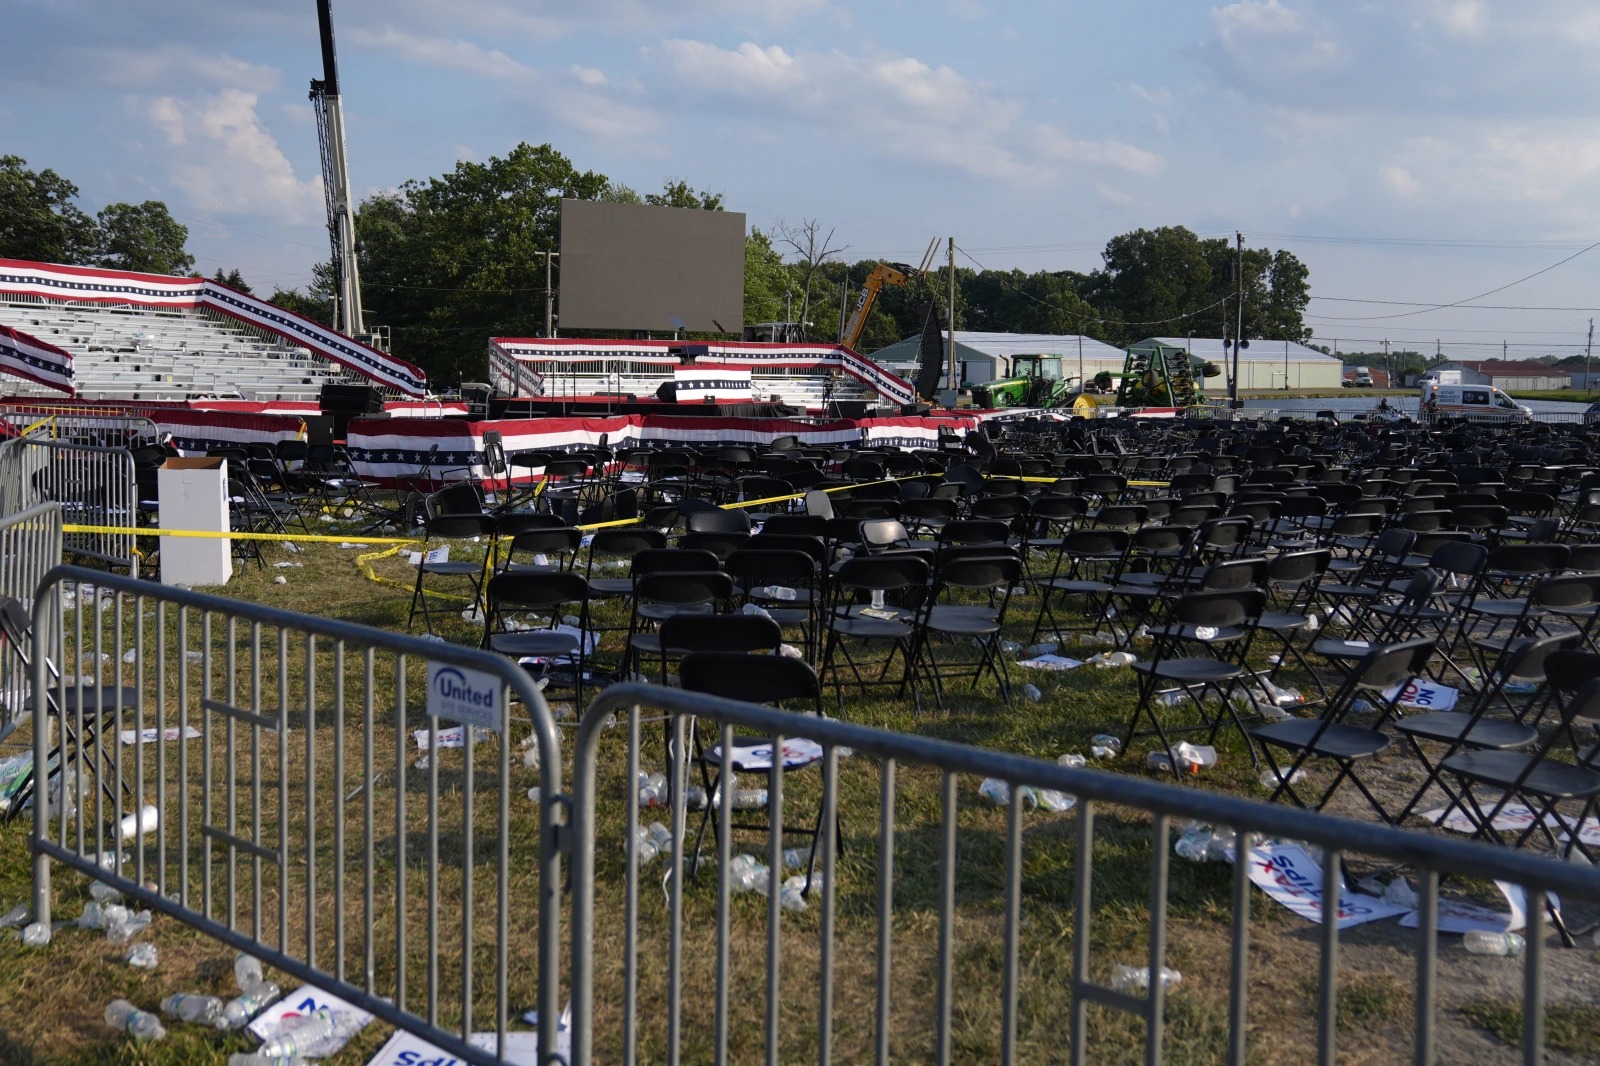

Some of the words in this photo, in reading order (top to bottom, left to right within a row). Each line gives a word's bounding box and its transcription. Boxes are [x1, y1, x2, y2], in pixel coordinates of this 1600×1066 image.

[857, 288, 868, 311] JCB
[440, 677, 494, 708] United
[1401, 683, 1419, 703] NO
[1416, 688, 1435, 705] ON
[1256, 859, 1307, 897] TAX
[1272, 855, 1325, 897] TIPS
